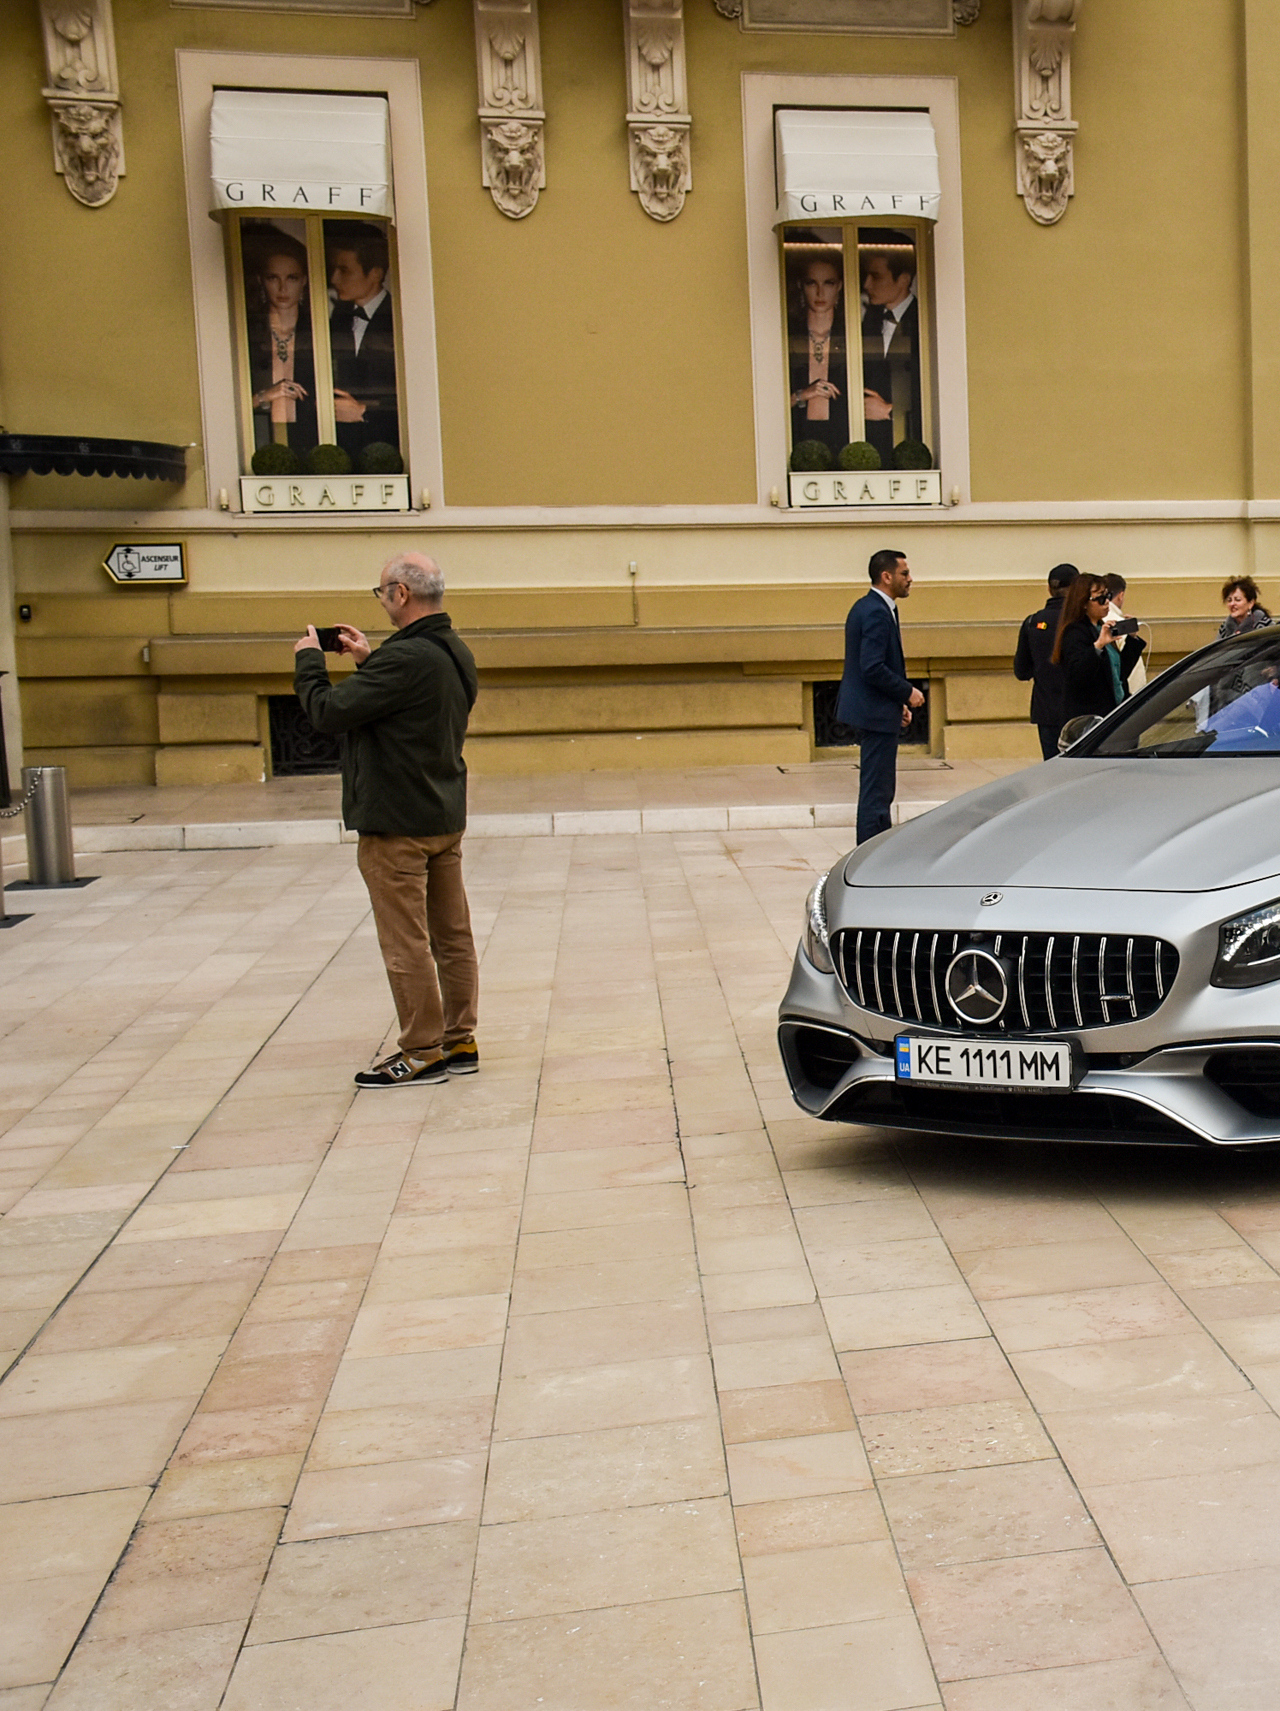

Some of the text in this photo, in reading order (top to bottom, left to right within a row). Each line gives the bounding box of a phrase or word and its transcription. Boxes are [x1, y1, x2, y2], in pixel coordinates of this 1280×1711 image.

[226, 182, 372, 206] GRAFF
[800, 194, 930, 213] GRAFF
[255, 484, 394, 506] GRAFF
[803, 479, 928, 501] GRAFF
[141, 555, 179, 563] ASCENSEUR
[899, 1062, 910, 1072] UA
[917, 1044, 1061, 1081] KE 1111 MM
